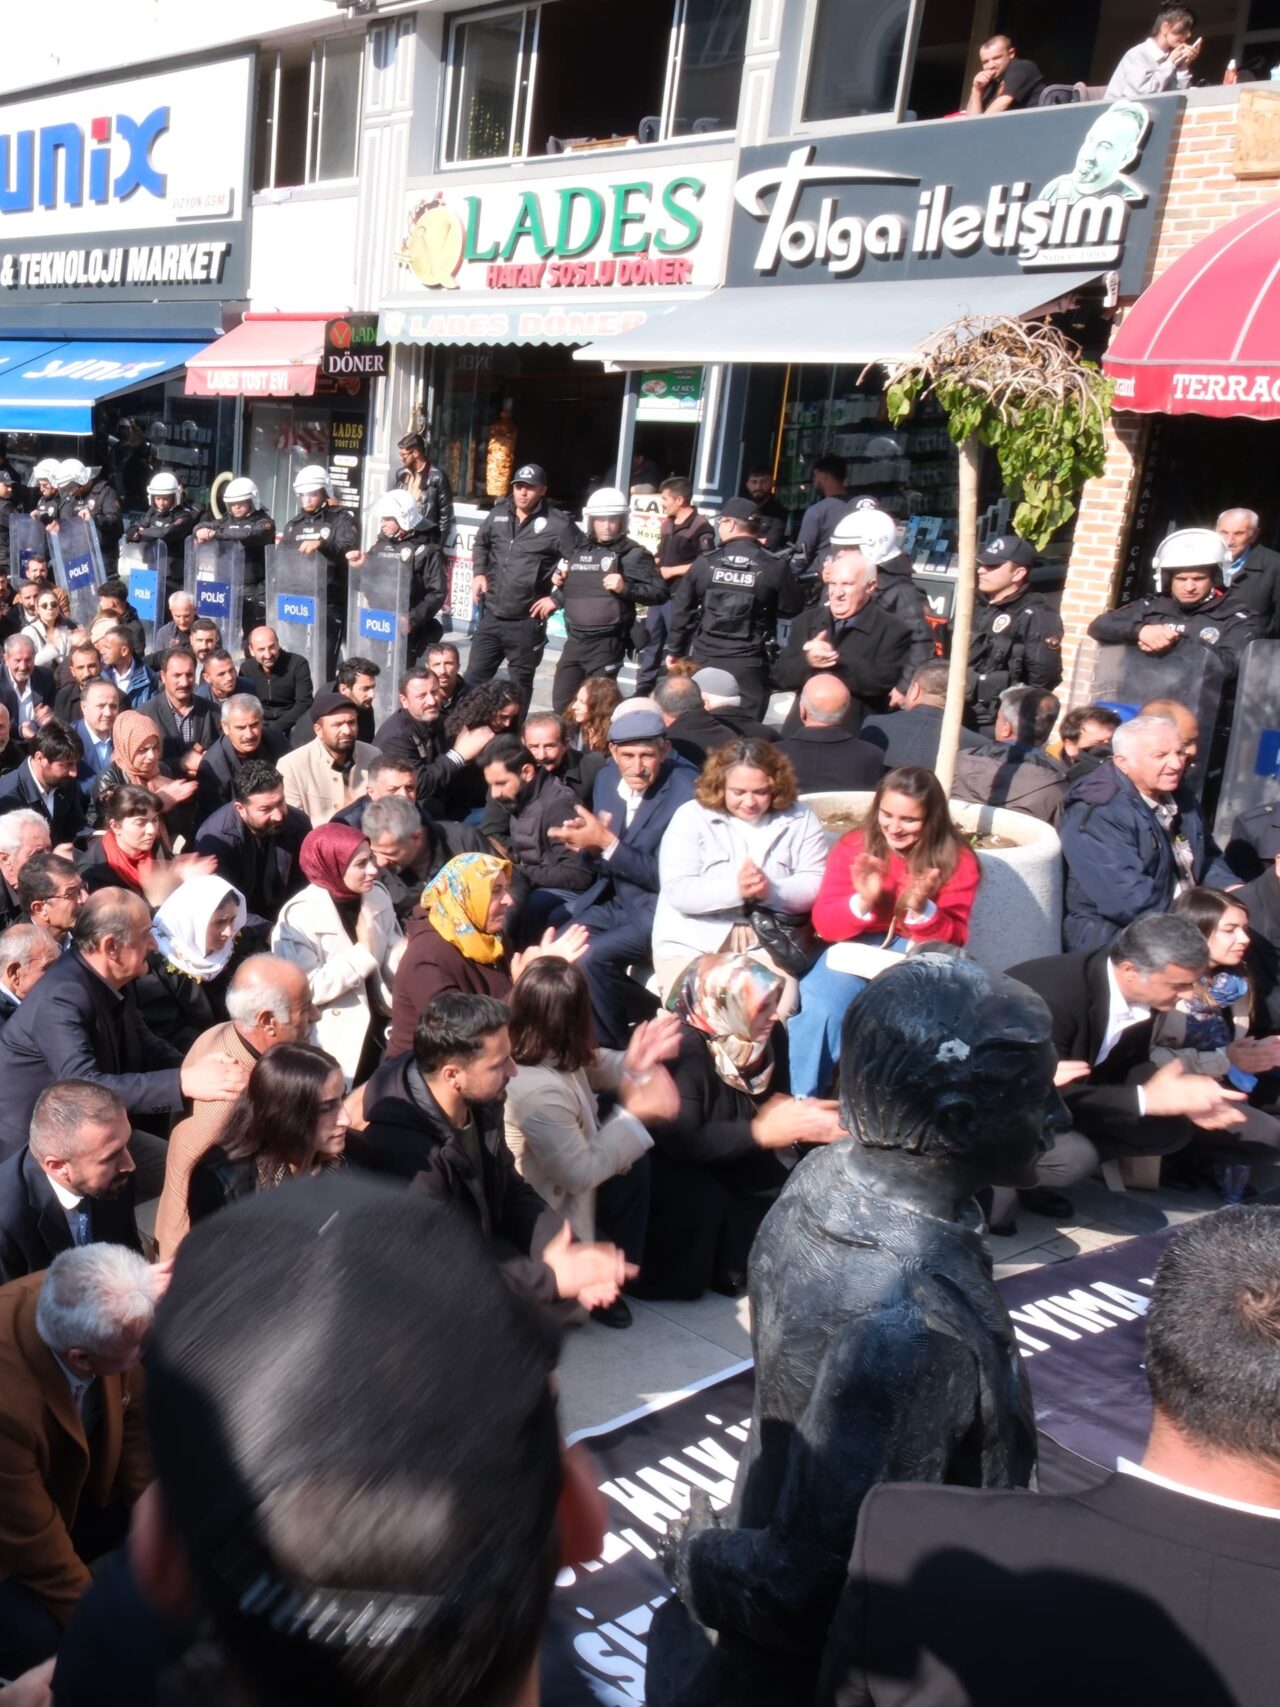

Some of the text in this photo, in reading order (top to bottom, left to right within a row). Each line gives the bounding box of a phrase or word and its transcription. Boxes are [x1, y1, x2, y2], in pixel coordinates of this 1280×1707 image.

[463, 176, 706, 262] LADES
[734, 145, 922, 273] Tolga
[0, 254, 18, 286] &
[126, 242, 228, 283] MARKET
[486, 250, 694, 289] HATAY SOSLU DÖNER
[351, 326, 376, 343] LAD
[408, 313, 508, 337] LADES
[328, 350, 384, 373] DÖNER
[207, 370, 239, 390] LADES
[241, 370, 268, 390] TOST
[332, 423, 364, 439] LADES
[69, 562, 89, 579] POLİS
[715, 571, 753, 585] POLİS
[1122, 546, 1139, 602] CAFE
[201, 590, 225, 604] POLİS
[284, 604, 308, 617] POLİS
[366, 618, 390, 633] POLİS
